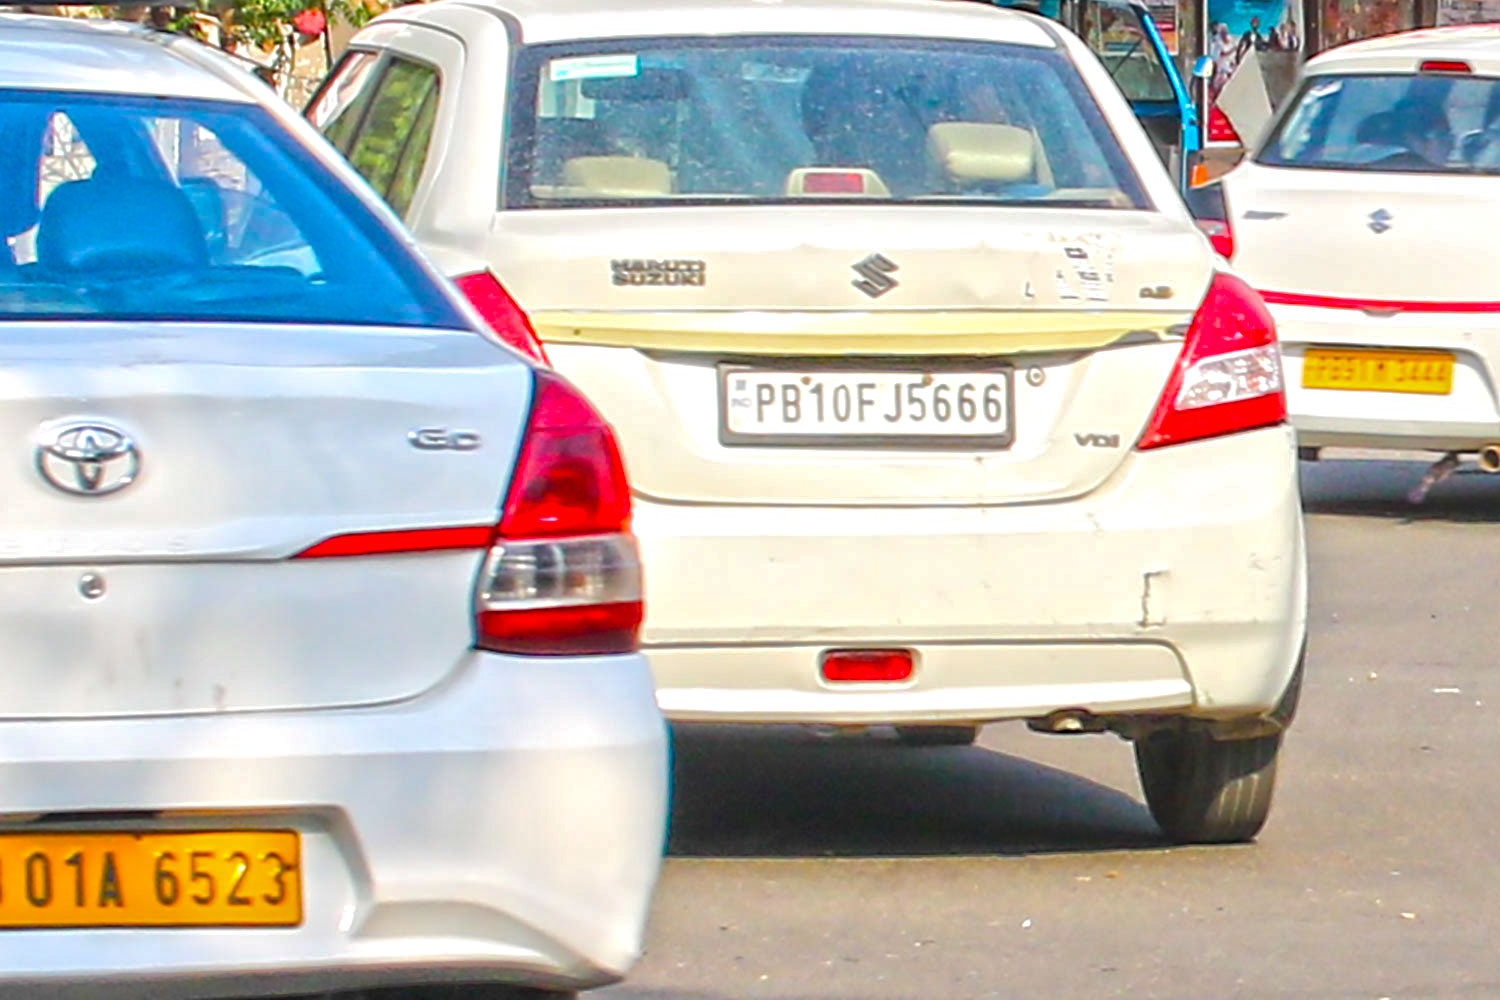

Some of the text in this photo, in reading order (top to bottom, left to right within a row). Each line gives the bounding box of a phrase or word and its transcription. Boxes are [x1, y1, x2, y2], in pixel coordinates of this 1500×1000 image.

[611, 259, 706, 272] MARUTI
[612, 271, 706, 286] SUZUKI
[757, 382, 1001, 423] PB10FJ5666
[154, 851, 287, 906] 6523
